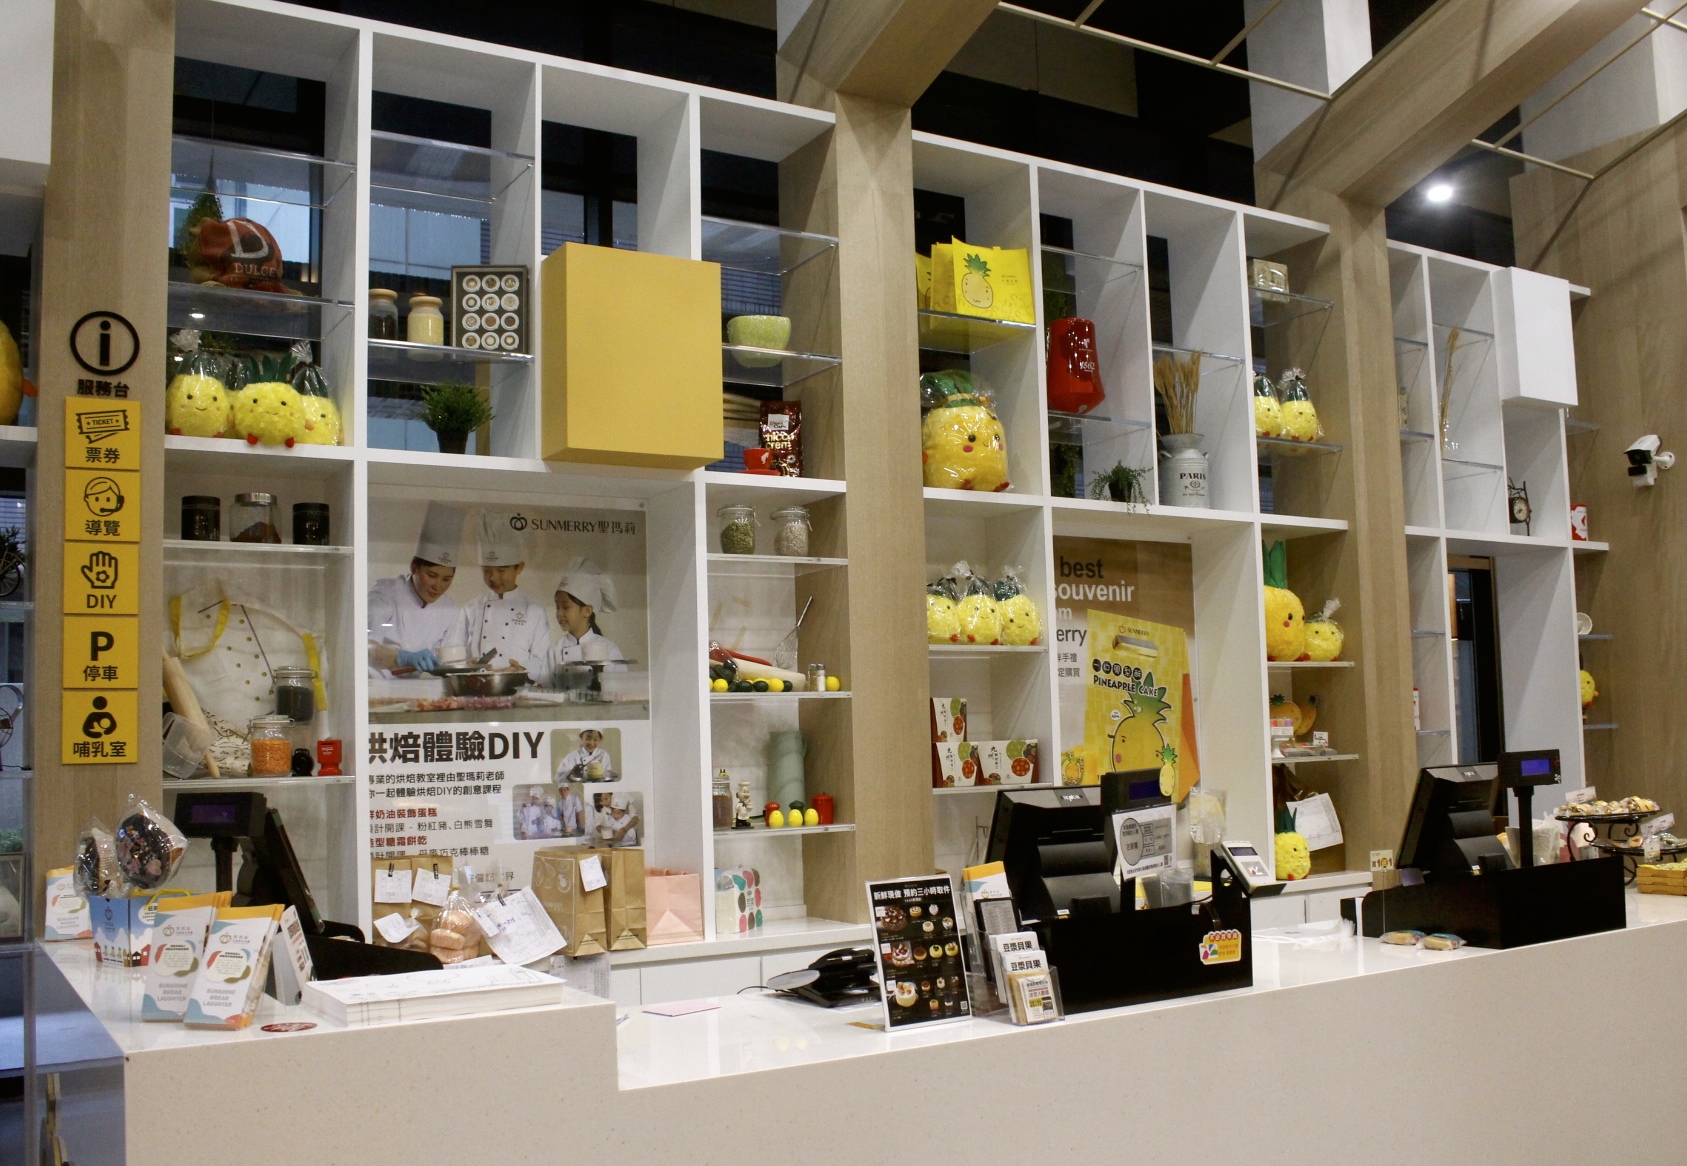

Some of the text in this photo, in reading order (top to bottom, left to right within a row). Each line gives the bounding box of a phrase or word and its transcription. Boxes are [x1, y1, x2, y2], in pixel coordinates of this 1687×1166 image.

[77, 379, 130, 398] 服務台
[92, 418, 114, 426] TICKET
[85, 447, 121, 464] 票券
[1179, 472, 1207, 480] PARIS
[85, 520, 121, 537] 導覽
[531, 518, 636, 535] SUNMERRY 聖瑪莉
[1059, 556, 1104, 579] best
[86, 594, 118, 609] DIY
[90, 631, 115, 662] P
[83, 665, 119, 682] 停車
[1093, 674, 1159, 697] PINEAPPLE CAKE
[73, 741, 127, 758] 哺乳室
[1002, 940, 1033, 953] 豆漿貝果
[1010, 959, 1042, 972] 豆漿貝果
